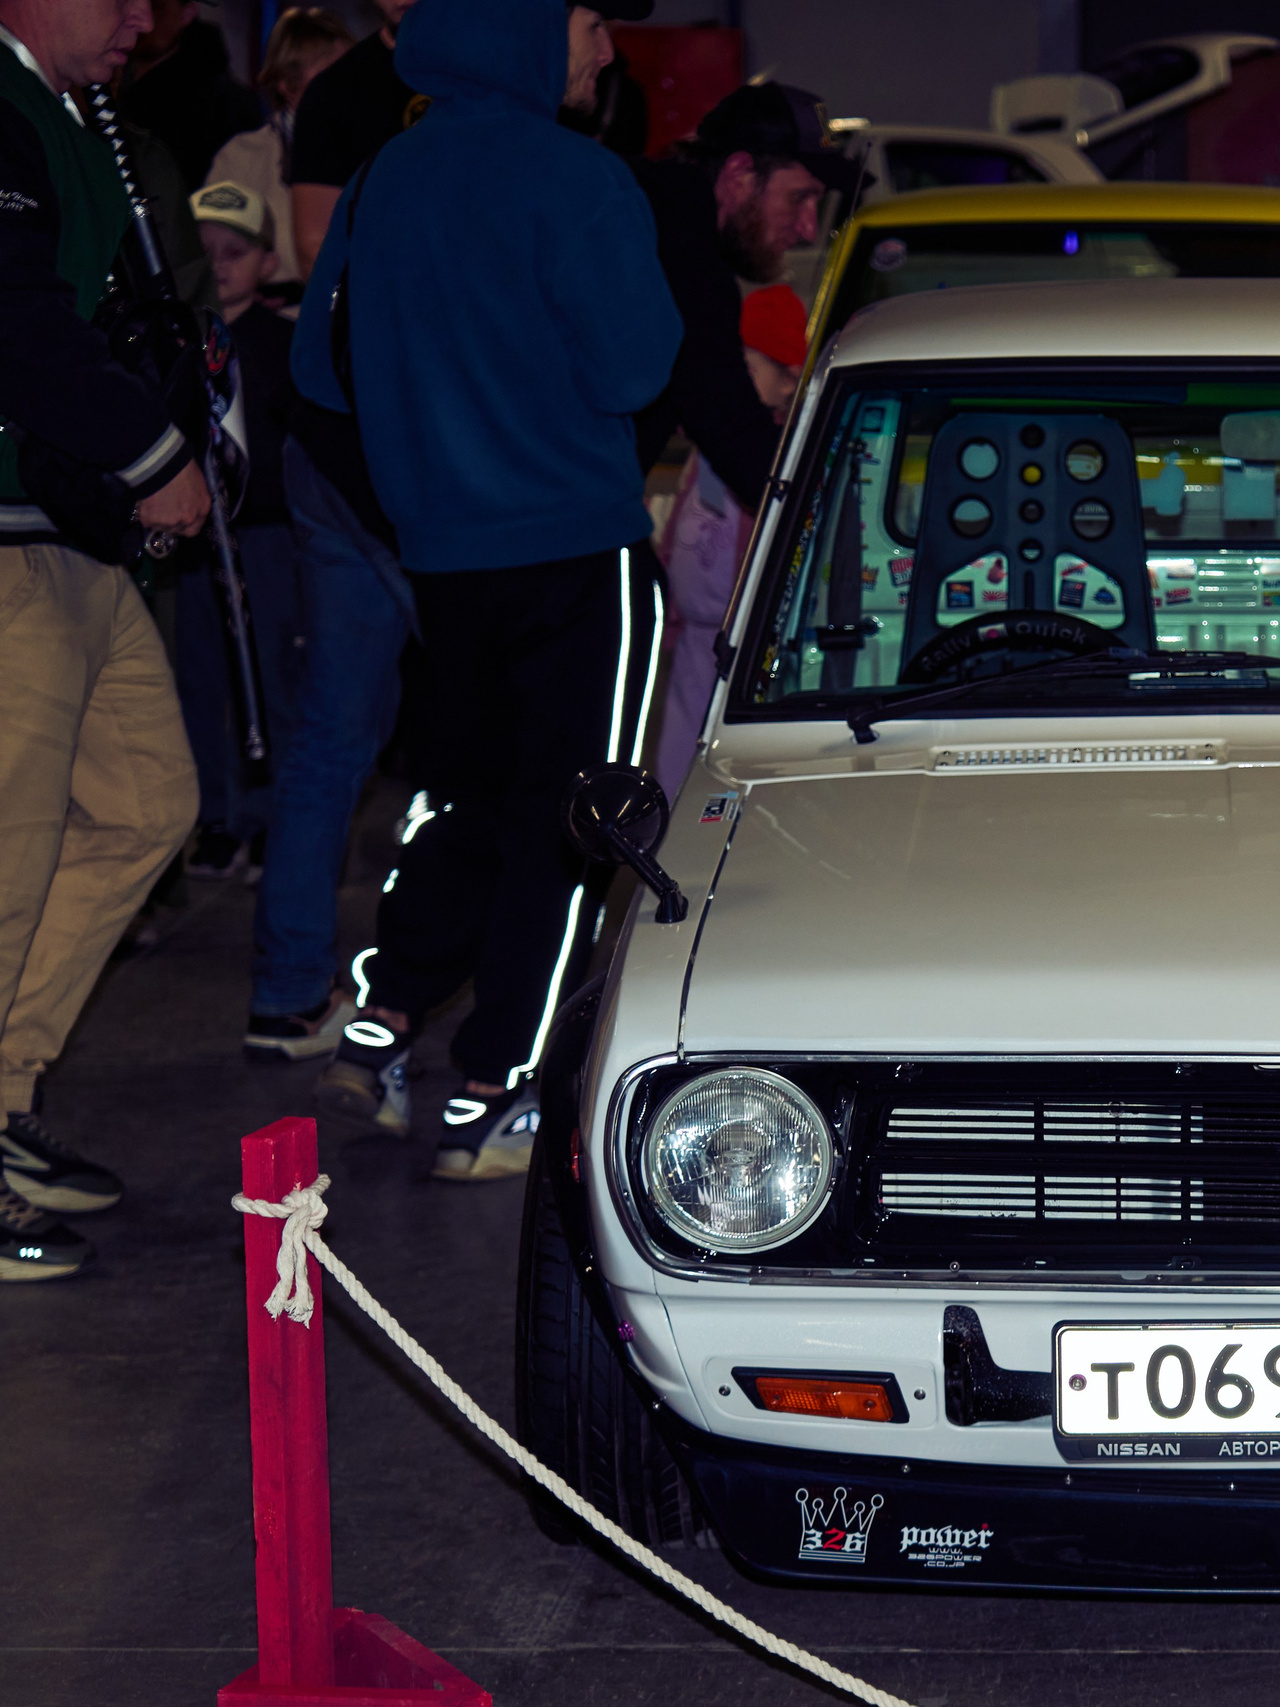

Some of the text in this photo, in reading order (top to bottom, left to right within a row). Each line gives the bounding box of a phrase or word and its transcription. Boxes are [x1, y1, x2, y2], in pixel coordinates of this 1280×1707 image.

[918, 620, 1088, 671] Rally Quick
[1097, 1443, 1181, 1456] NISSAN
[803, 1527, 865, 1552] 326
[899, 1522, 994, 1552] power
